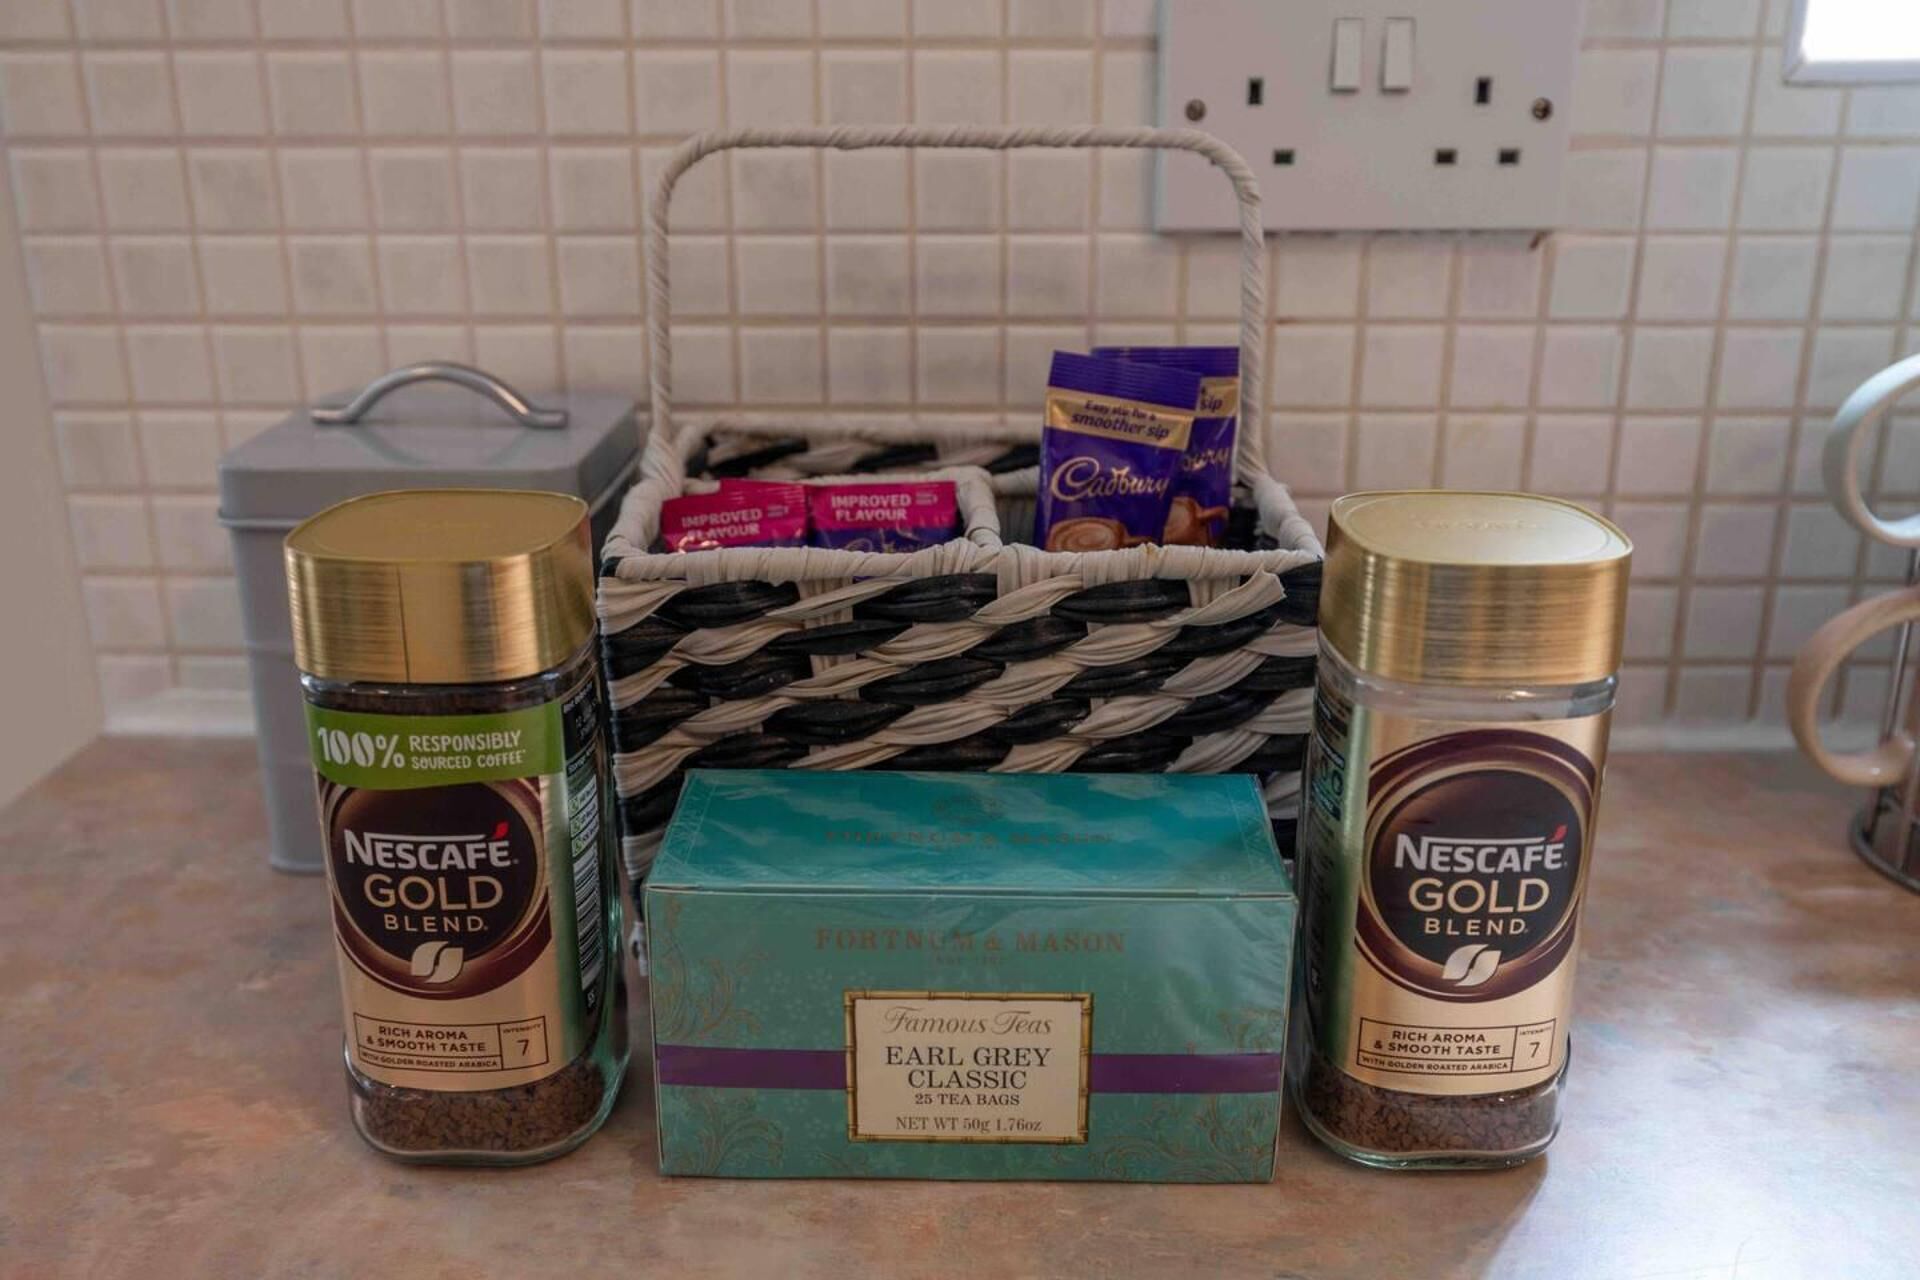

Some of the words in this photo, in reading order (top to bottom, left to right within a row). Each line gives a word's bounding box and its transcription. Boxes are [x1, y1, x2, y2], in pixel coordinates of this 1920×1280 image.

[1071, 411, 1147, 436] smoother
[1147, 422, 1170, 440] sip
[1051, 456, 1171, 502] Cadbury
[831, 493, 912, 509] IMPROVED
[681, 508, 763, 528] IMPROVED
[835, 507, 908, 522] FLAVOUR
[317, 726, 406, 769] 100%
[409, 729, 522, 753] RESPONSIBLY
[411, 755, 472, 770] SOURCED
[363, 873, 504, 911] GOLD
[1408, 877, 1550, 914] GOLD
[383, 914, 486, 933] BLEND
[1424, 918, 1527, 936] BLEND
[814, 927, 974, 952] FORTNUM
[983, 930, 1003, 952] &
[1015, 930, 1126, 953] MASON
[883, 1005, 988, 1036] Famous
[990, 1009, 1053, 1037] Teas
[378, 1025, 411, 1038] RICH
[415, 1029, 468, 1041] AROMA
[1391, 1030, 1428, 1042] RICH
[1432, 1033, 1486, 1043] AROMA
[377, 1037, 436, 1052] SMOOTH
[442, 1042, 487, 1052] TASTE
[517, 1039, 530, 1057] 7
[1388, 1041, 1450, 1056] SMOOTH
[1456, 1045, 1502, 1055] TASTE
[1529, 1041, 1541, 1059] 7
[380, 1055, 414, 1066] GOLDEN
[416, 1059, 456, 1068] ROASTED
[458, 1060, 498, 1068] ARABICA
[885, 1046, 964, 1067] EARL
[972, 1046, 1051, 1068] GREY
[1387, 1059, 1425, 1071] GOLDEN
[1427, 1062, 1467, 1072] ROASTED
[1470, 1062, 1509, 1072] ARABICA
[907, 1069, 1028, 1090] CLASSIC
[914, 1093, 933, 1106] 25
[937, 1093, 971, 1106] TEA
[976, 1094, 1021, 1107] BAGS
[895, 1116, 930, 1132] NET
[933, 1117, 960, 1132] WT
[963, 1118, 991, 1135] 50g
[995, 1117, 1043, 1133] 1.76oz
